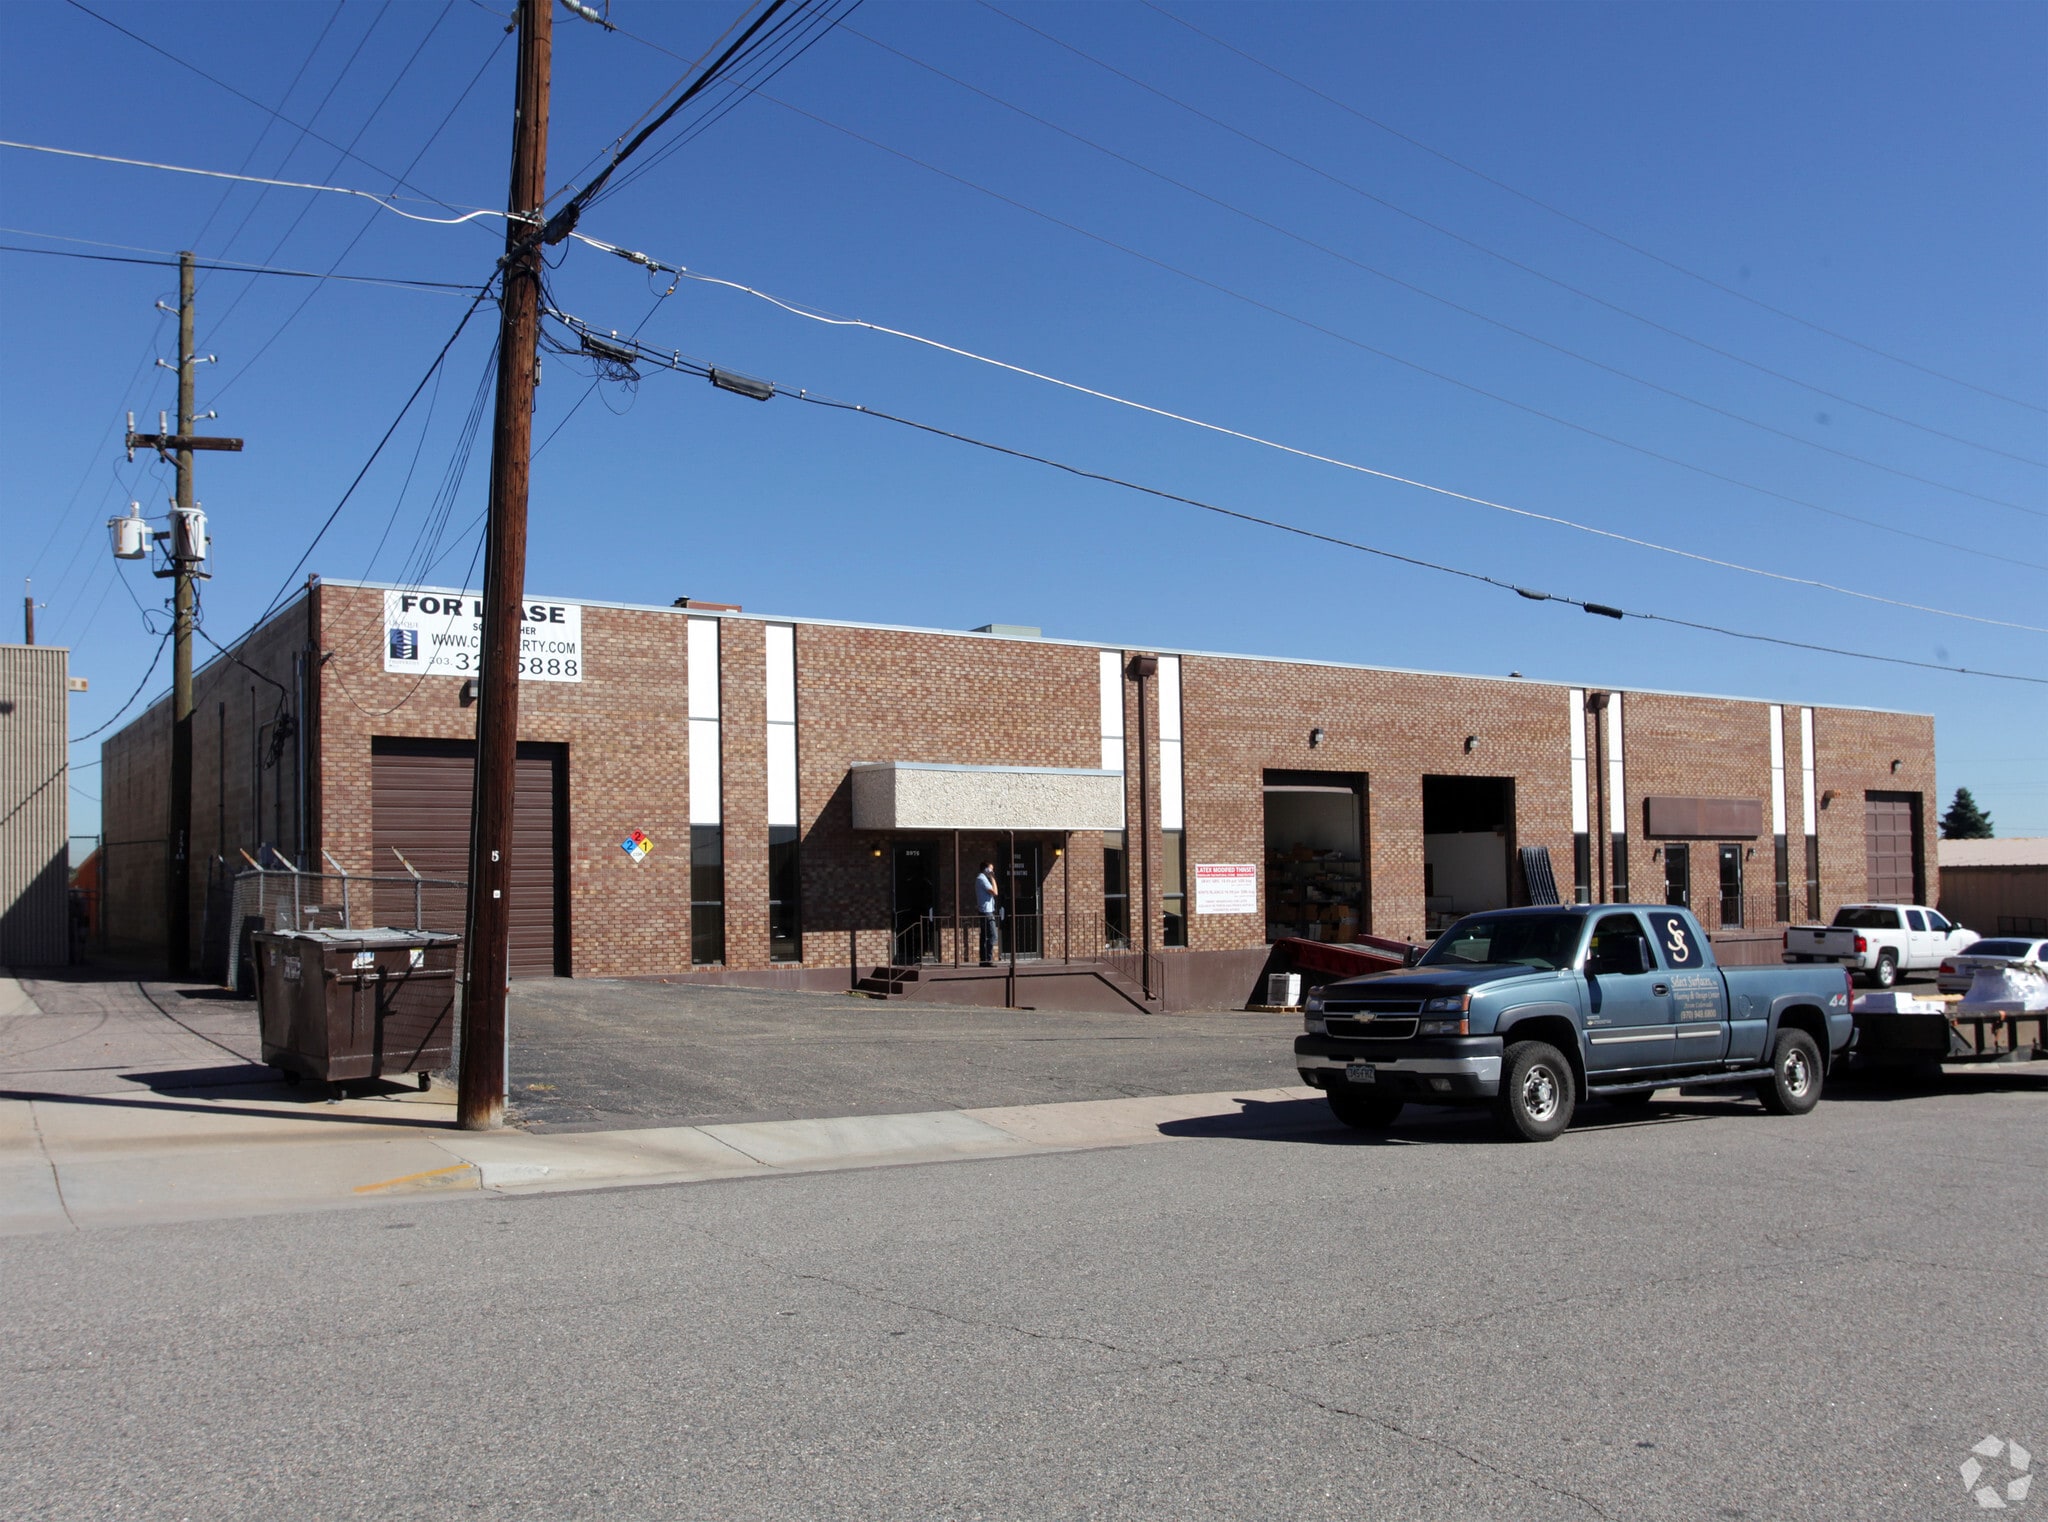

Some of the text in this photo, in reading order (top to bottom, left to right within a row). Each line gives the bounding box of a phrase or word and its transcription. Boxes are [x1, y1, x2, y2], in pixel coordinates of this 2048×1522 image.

[402, 595, 565, 624] FOR LSE
[432, 634, 576, 654] WWW.CRTY.COM
[635, 832, 641, 841] 2
[627, 840, 647, 851] 2 1
